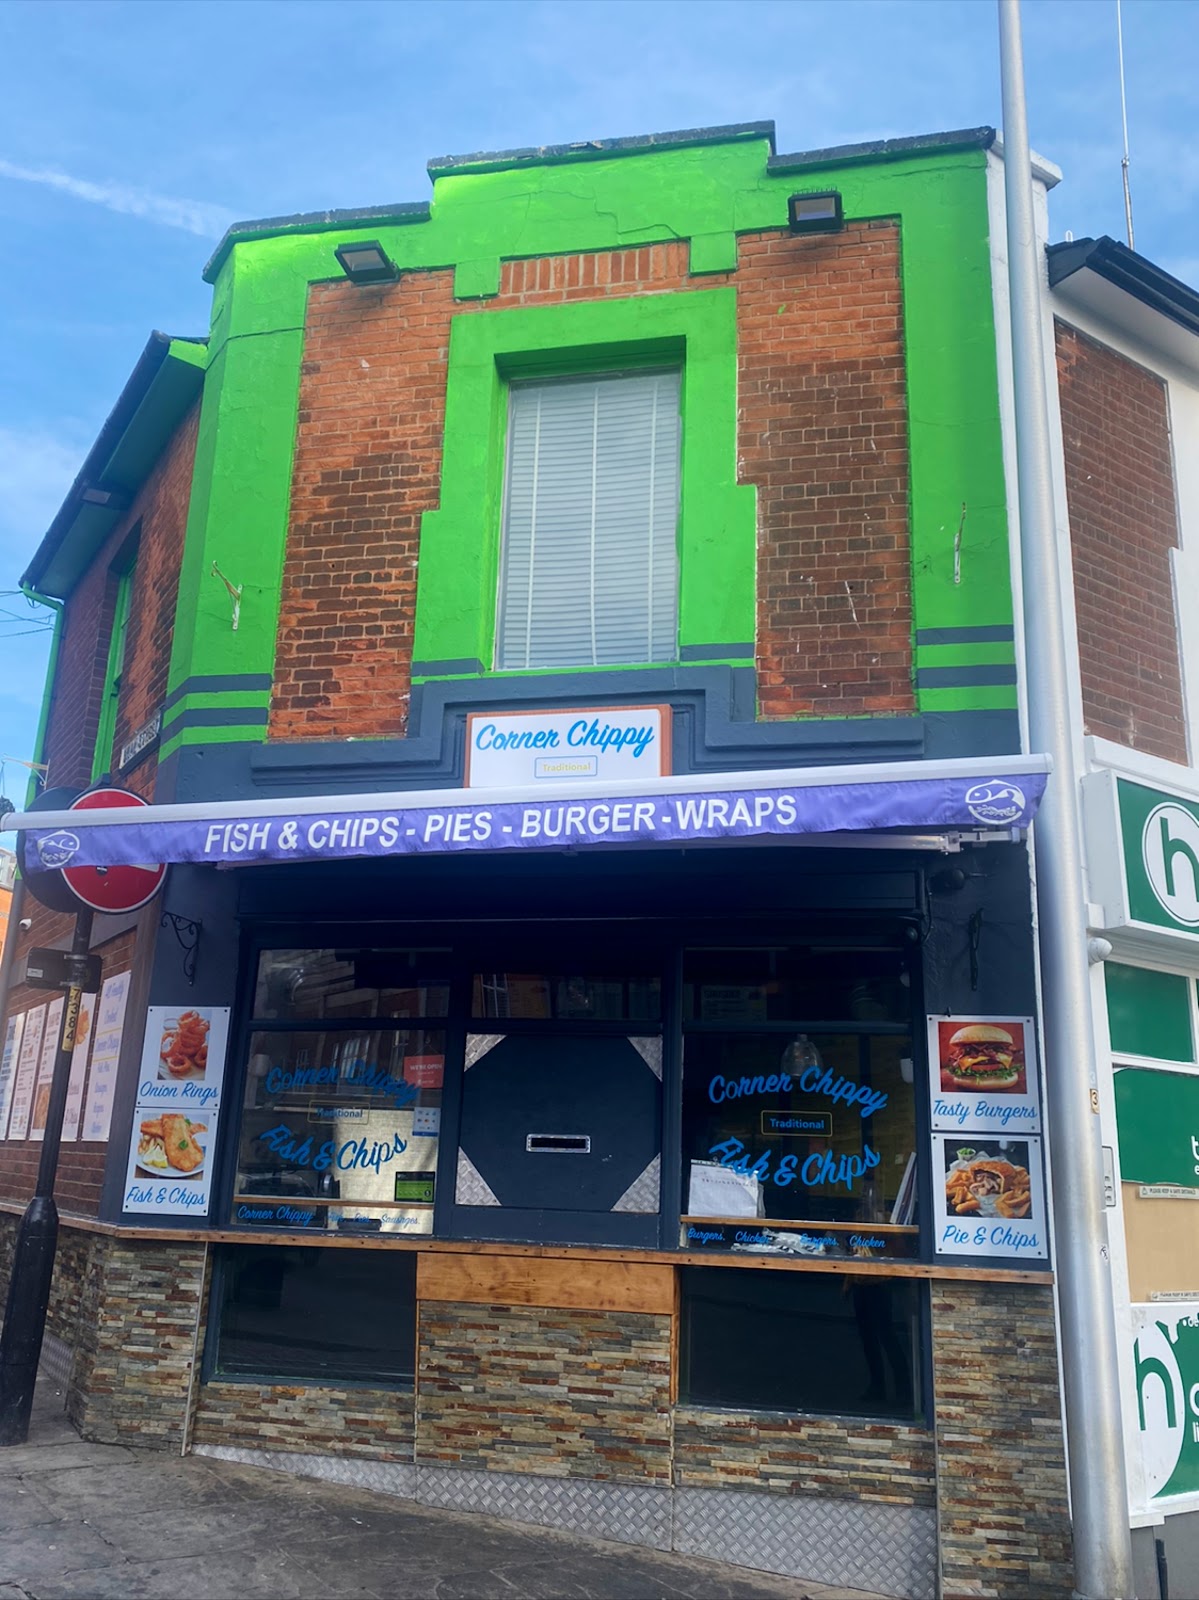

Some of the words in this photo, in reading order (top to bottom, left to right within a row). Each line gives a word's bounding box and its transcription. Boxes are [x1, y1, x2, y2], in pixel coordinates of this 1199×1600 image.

[476, 724, 560, 751] Corner
[567, 718, 655, 758] Chippy
[543, 762, 592, 773] Traditional
[204, 822, 272, 853] FISH
[278, 820, 298, 850] &
[307, 816, 399, 849] CHIPS
[423, 812, 492, 843] PIES
[520, 802, 656, 838] BURGER
[676, 795, 797, 830] WRAPS
[65, 988, 81, 1042] 7384
[140, 1081, 178, 1097] Onion
[180, 1082, 219, 1106] Rings
[265, 1066, 339, 1094] Corner
[349, 1058, 421, 1108] Chippy
[708, 1072, 793, 1103] Corner
[799, 1065, 888, 1118] Chippy
[769, 1118, 825, 1129] Traditional
[933, 1100, 970, 1125] Tasty
[974, 1101, 1038, 1125] Burgers
[260, 1124, 315, 1167] Fish
[312, 1141, 336, 1172] &
[336, 1132, 407, 1175] Chips
[709, 1136, 771, 1182] Fish
[773, 1155, 799, 1187] &
[801, 1144, 881, 1191] Chips
[126, 1186, 154, 1203] Fish
[155, 1188, 167, 1204] &
[169, 1187, 206, 1209] Chips
[237, 1205, 273, 1221] Corner
[276, 1205, 314, 1227] Chippy
[735, 1230, 769, 1243] Chicken
[850, 1234, 886, 1248] Chicken
[942, 1225, 970, 1243] Pie
[973, 1226, 987, 1245] &
[990, 1226, 1039, 1252] Chips
